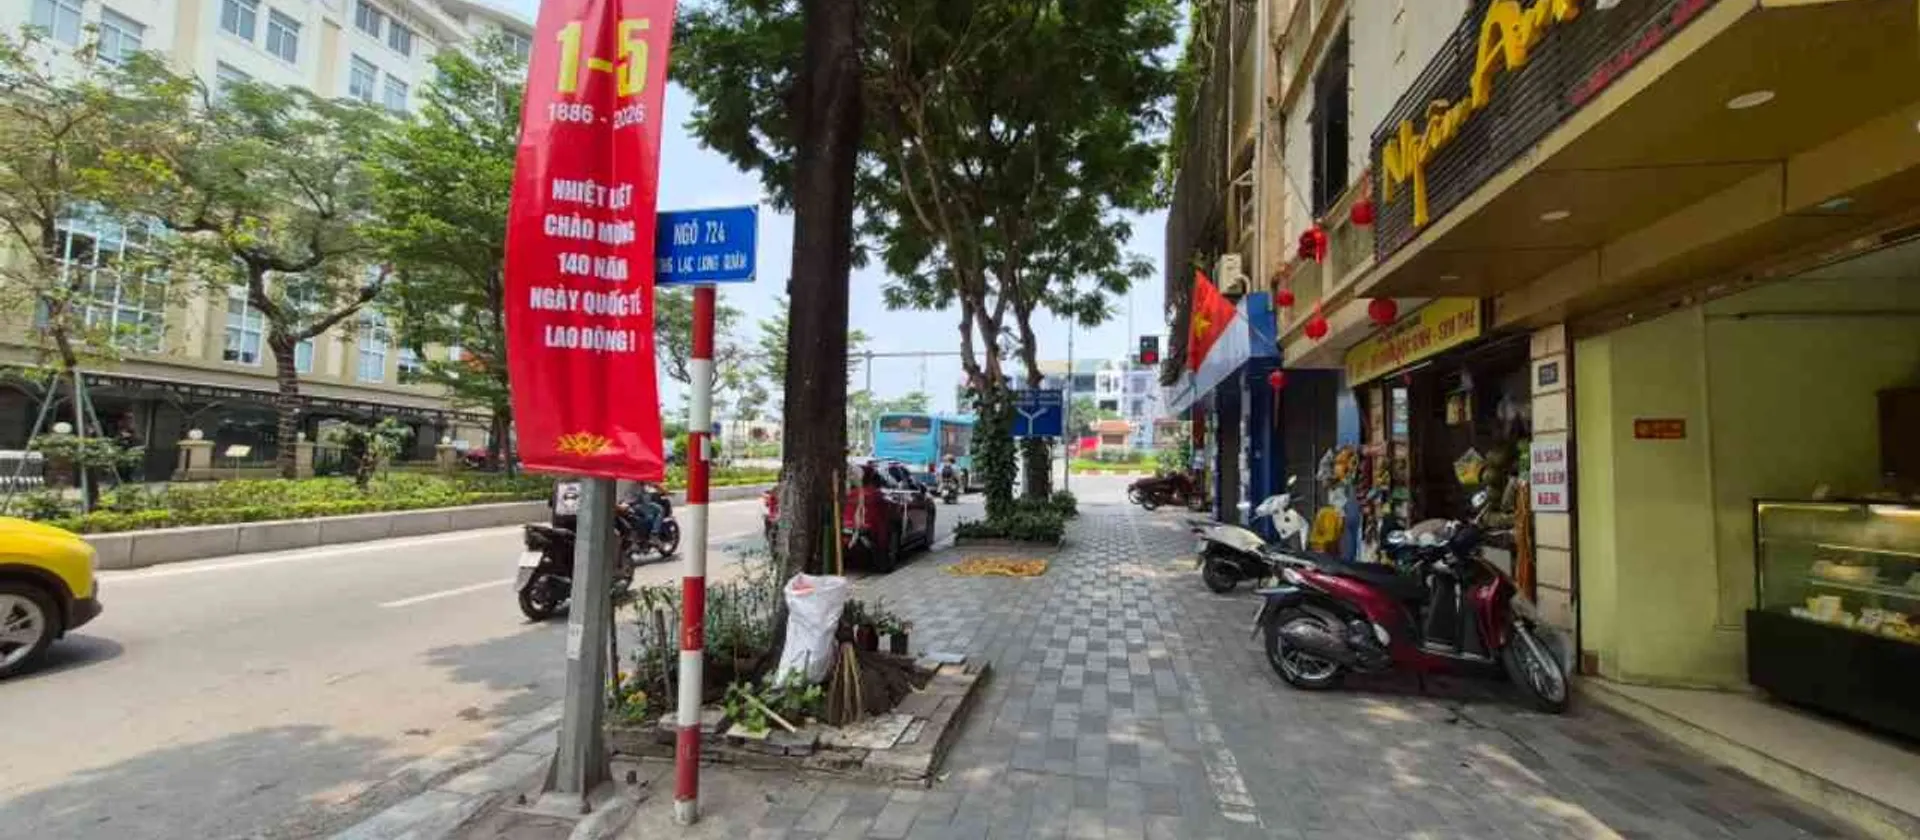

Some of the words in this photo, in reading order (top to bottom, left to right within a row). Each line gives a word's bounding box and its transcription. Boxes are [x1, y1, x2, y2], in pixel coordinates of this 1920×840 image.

[548, 102, 594, 124] 1886
[552, 178, 607, 208] NHIỆT
[543, 212, 595, 240] CHÀO
[558, 252, 591, 276] 140
[530, 283, 580, 312] NGÀY
[583, 287, 629, 317] QUỐC
[545, 323, 579, 348] LAO
